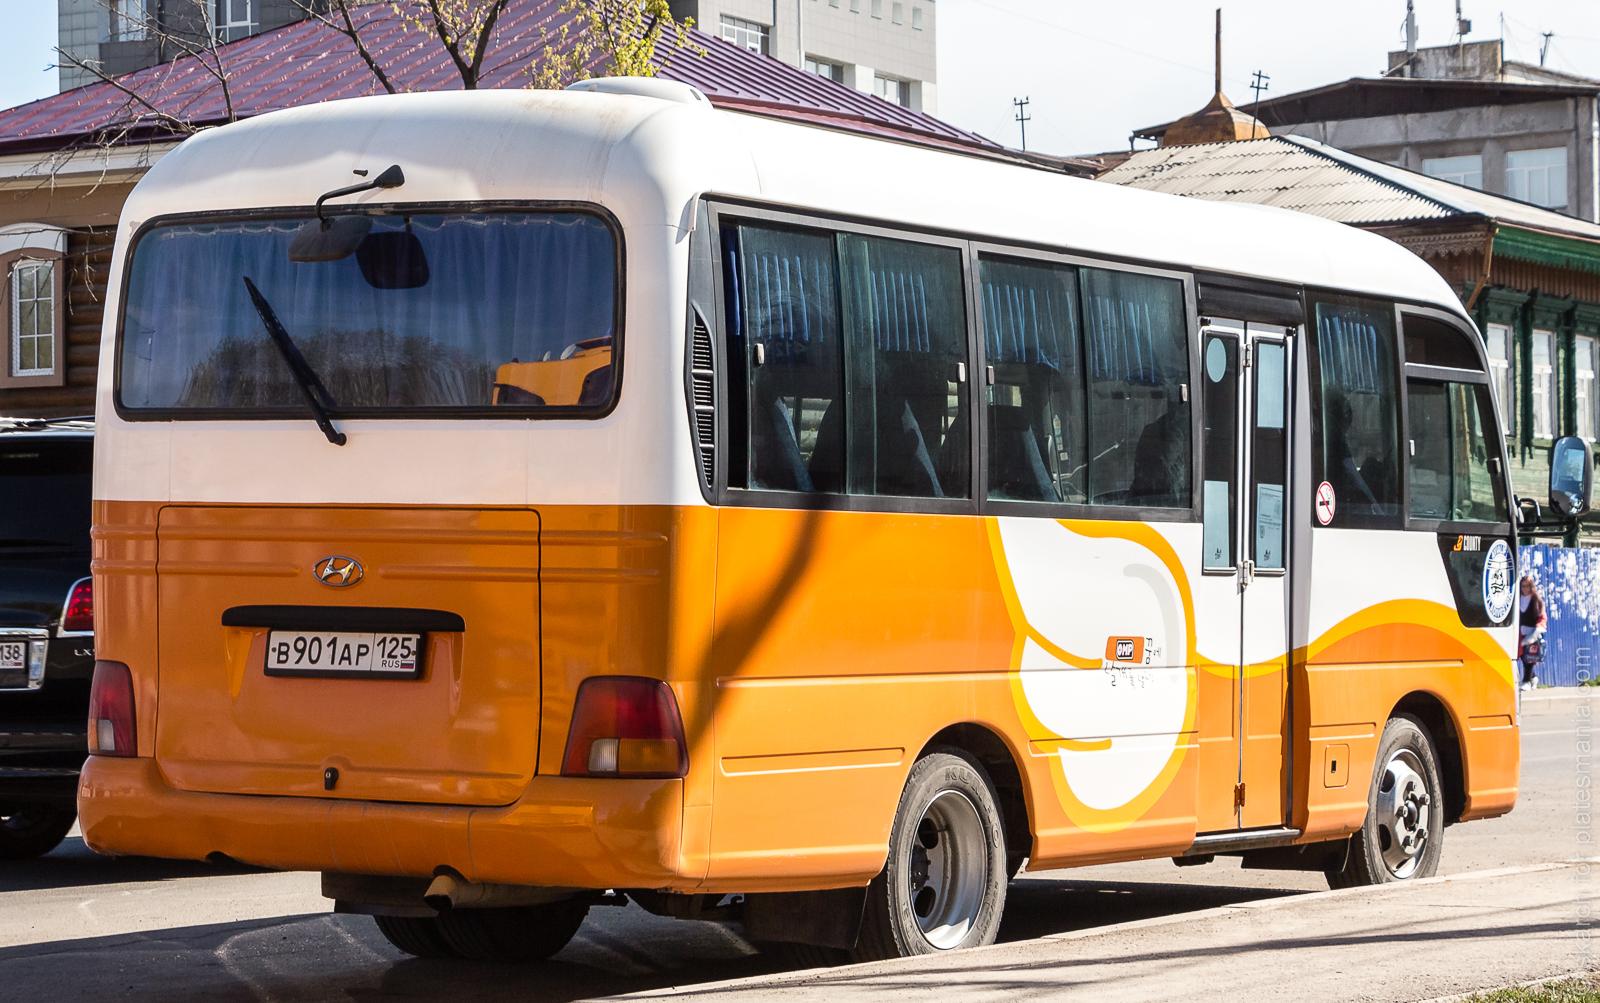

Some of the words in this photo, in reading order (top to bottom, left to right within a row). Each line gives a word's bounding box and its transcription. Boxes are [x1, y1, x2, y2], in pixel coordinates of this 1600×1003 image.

[1463, 536, 1481, 551] COUNTY
[0, 644, 20, 661] 138
[376, 636, 413, 659] 125
[1116, 643, 1134, 658] OMP
[381, 659, 400, 669] RUS
